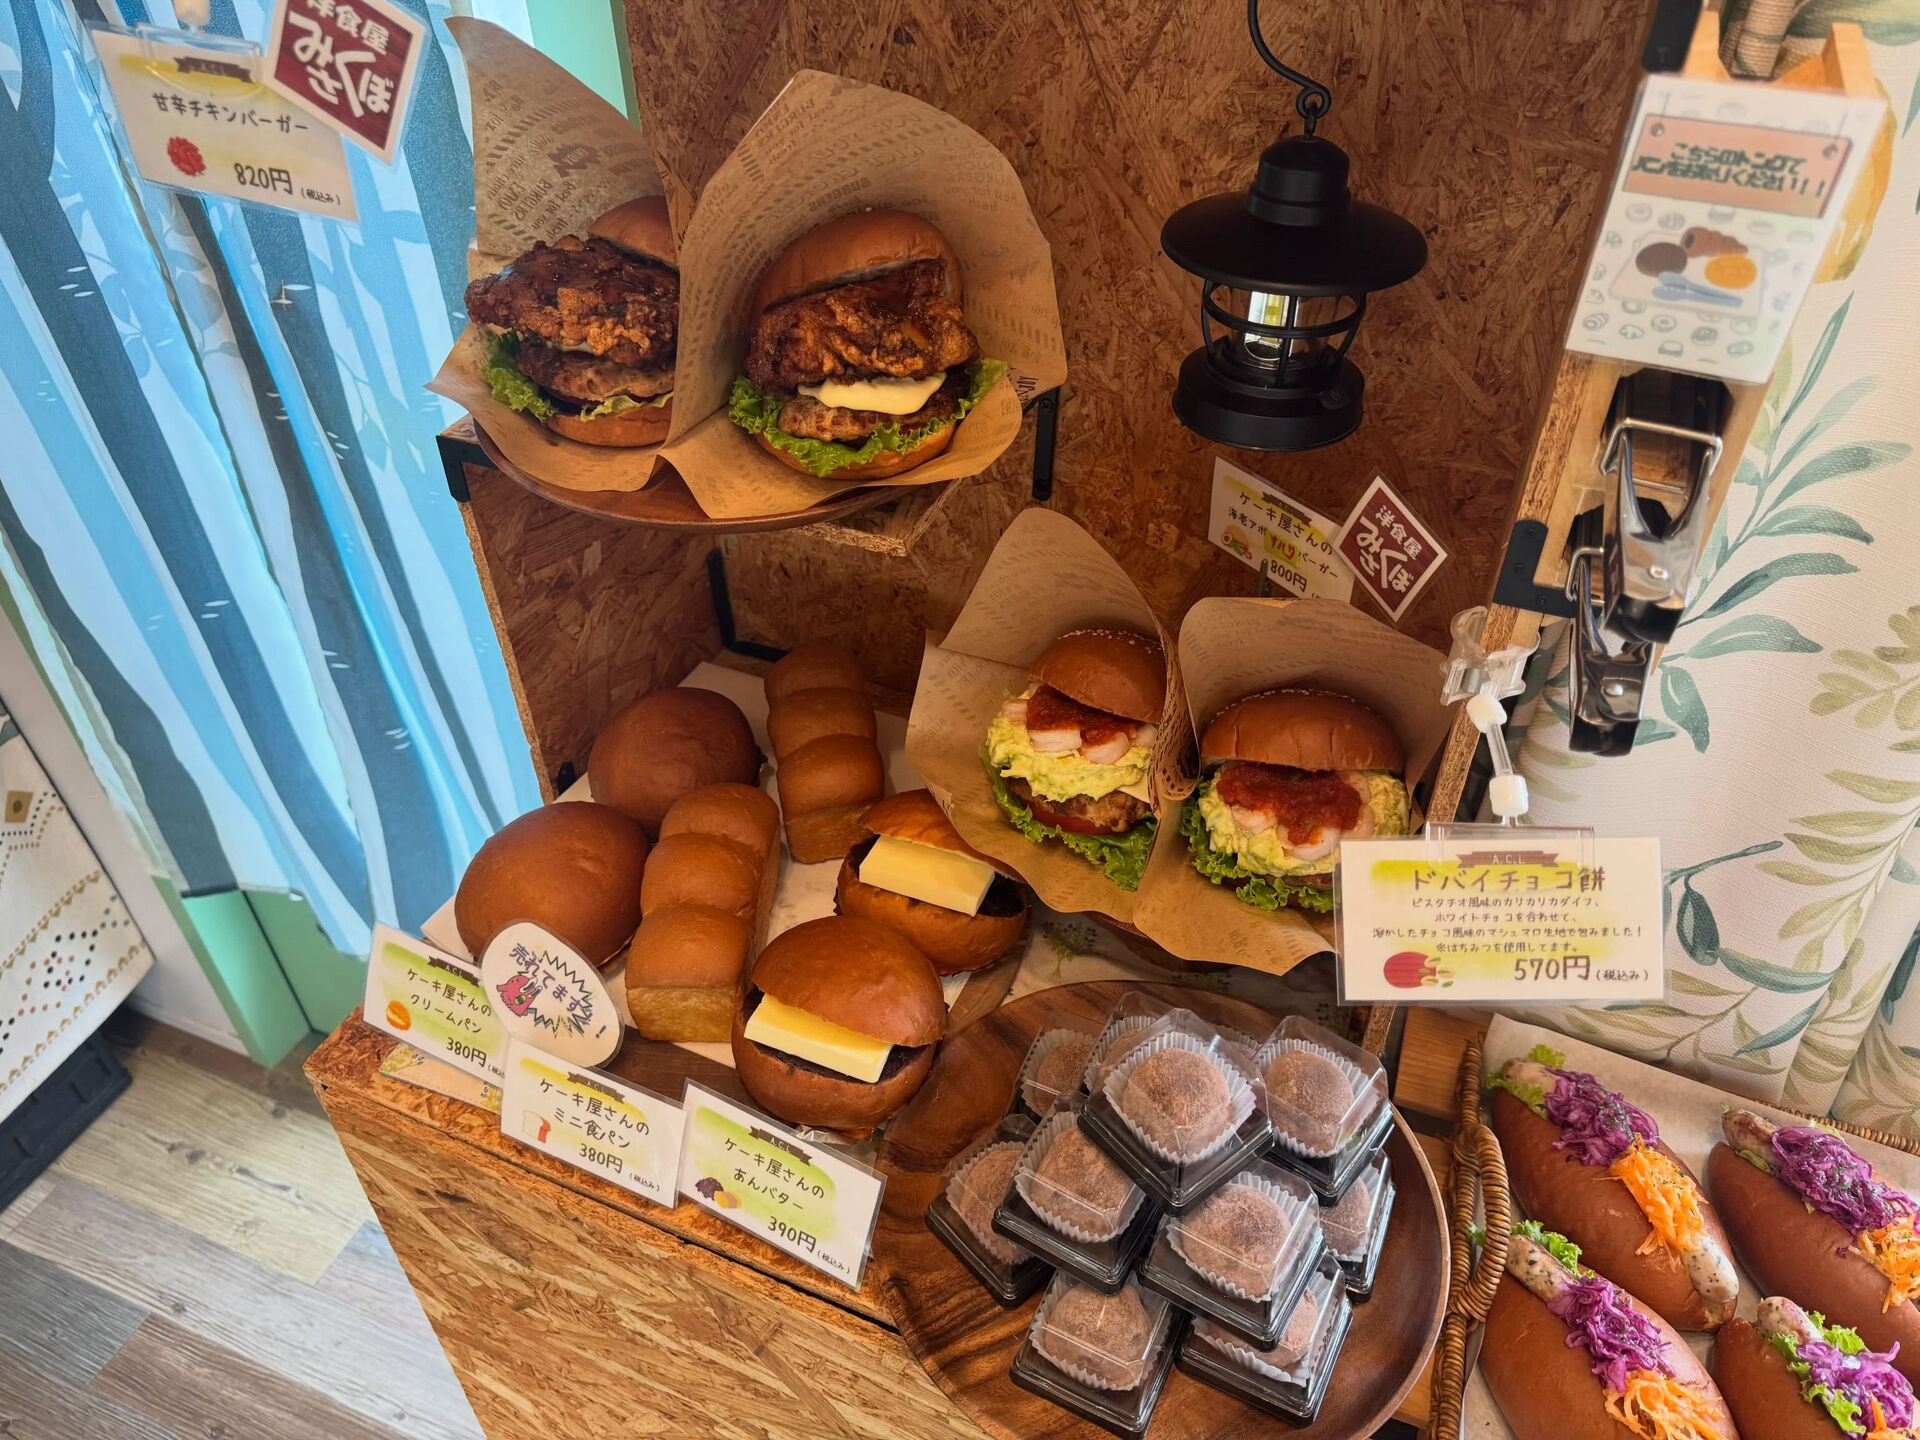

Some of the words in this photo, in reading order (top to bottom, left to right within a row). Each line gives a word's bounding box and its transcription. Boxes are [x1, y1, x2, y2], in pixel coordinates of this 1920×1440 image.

[153, 92, 308, 133] 甘辛チキンバーガー
[234, 163, 293, 195] 820円
[1239, 491, 1333, 556] ケーキ屋さんの
[1375, 505, 1423, 561] 洋食屋
[1270, 560, 1308, 592] 800円
[1413, 867, 1606, 892] ドバイチョコ餅
[1514, 955, 1590, 981] 570円
[407, 968, 492, 1017] ケーキ屋さんの
[410, 993, 482, 1034] クリームパン
[446, 1036, 487, 1068] 380円
[539, 1078, 649, 1136] ケーキ屋さんの
[553, 1106, 632, 1149] ミニ食パン
[579, 1143, 623, 1174] 380円
[724, 1137, 825, 1199] ケーキ屋さんの
[733, 1166, 804, 1211] あんバター
[768, 1215, 817, 1253] 390円
